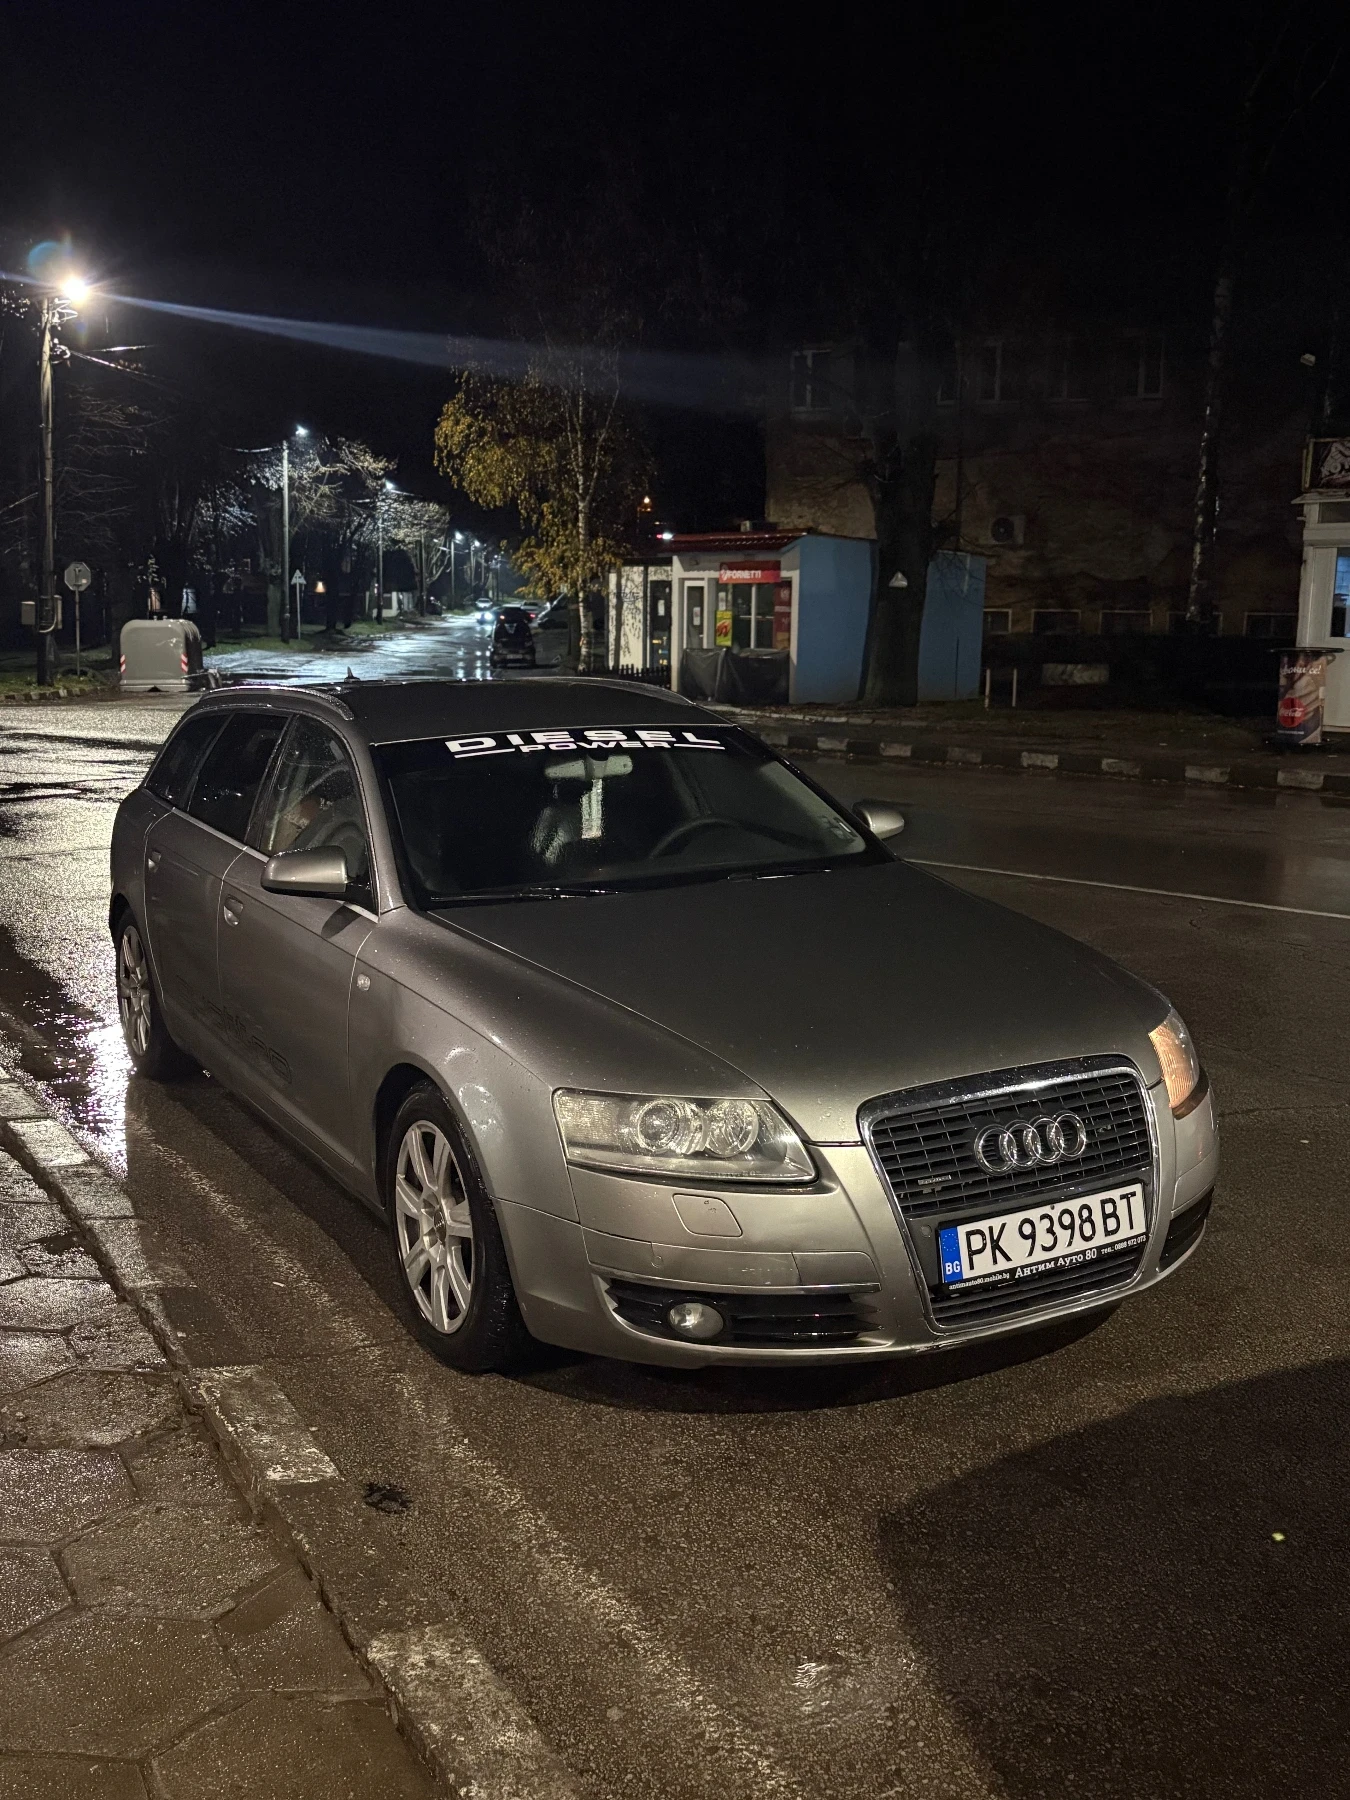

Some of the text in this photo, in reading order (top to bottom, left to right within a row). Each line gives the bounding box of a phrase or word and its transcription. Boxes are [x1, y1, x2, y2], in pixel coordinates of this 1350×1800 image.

[728, 570, 761, 579] FORNETTI
[445, 730, 720, 752] DIESEL
[520, 741, 675, 753] POWER
[965, 1192, 1137, 1270] PK 9398 BT
[945, 1261, 960, 1275] BG
[1015, 1248, 1097, 1279] Антим Ауто 80
[949, 1273, 1010, 1290] antimauto80.mobile.bg
